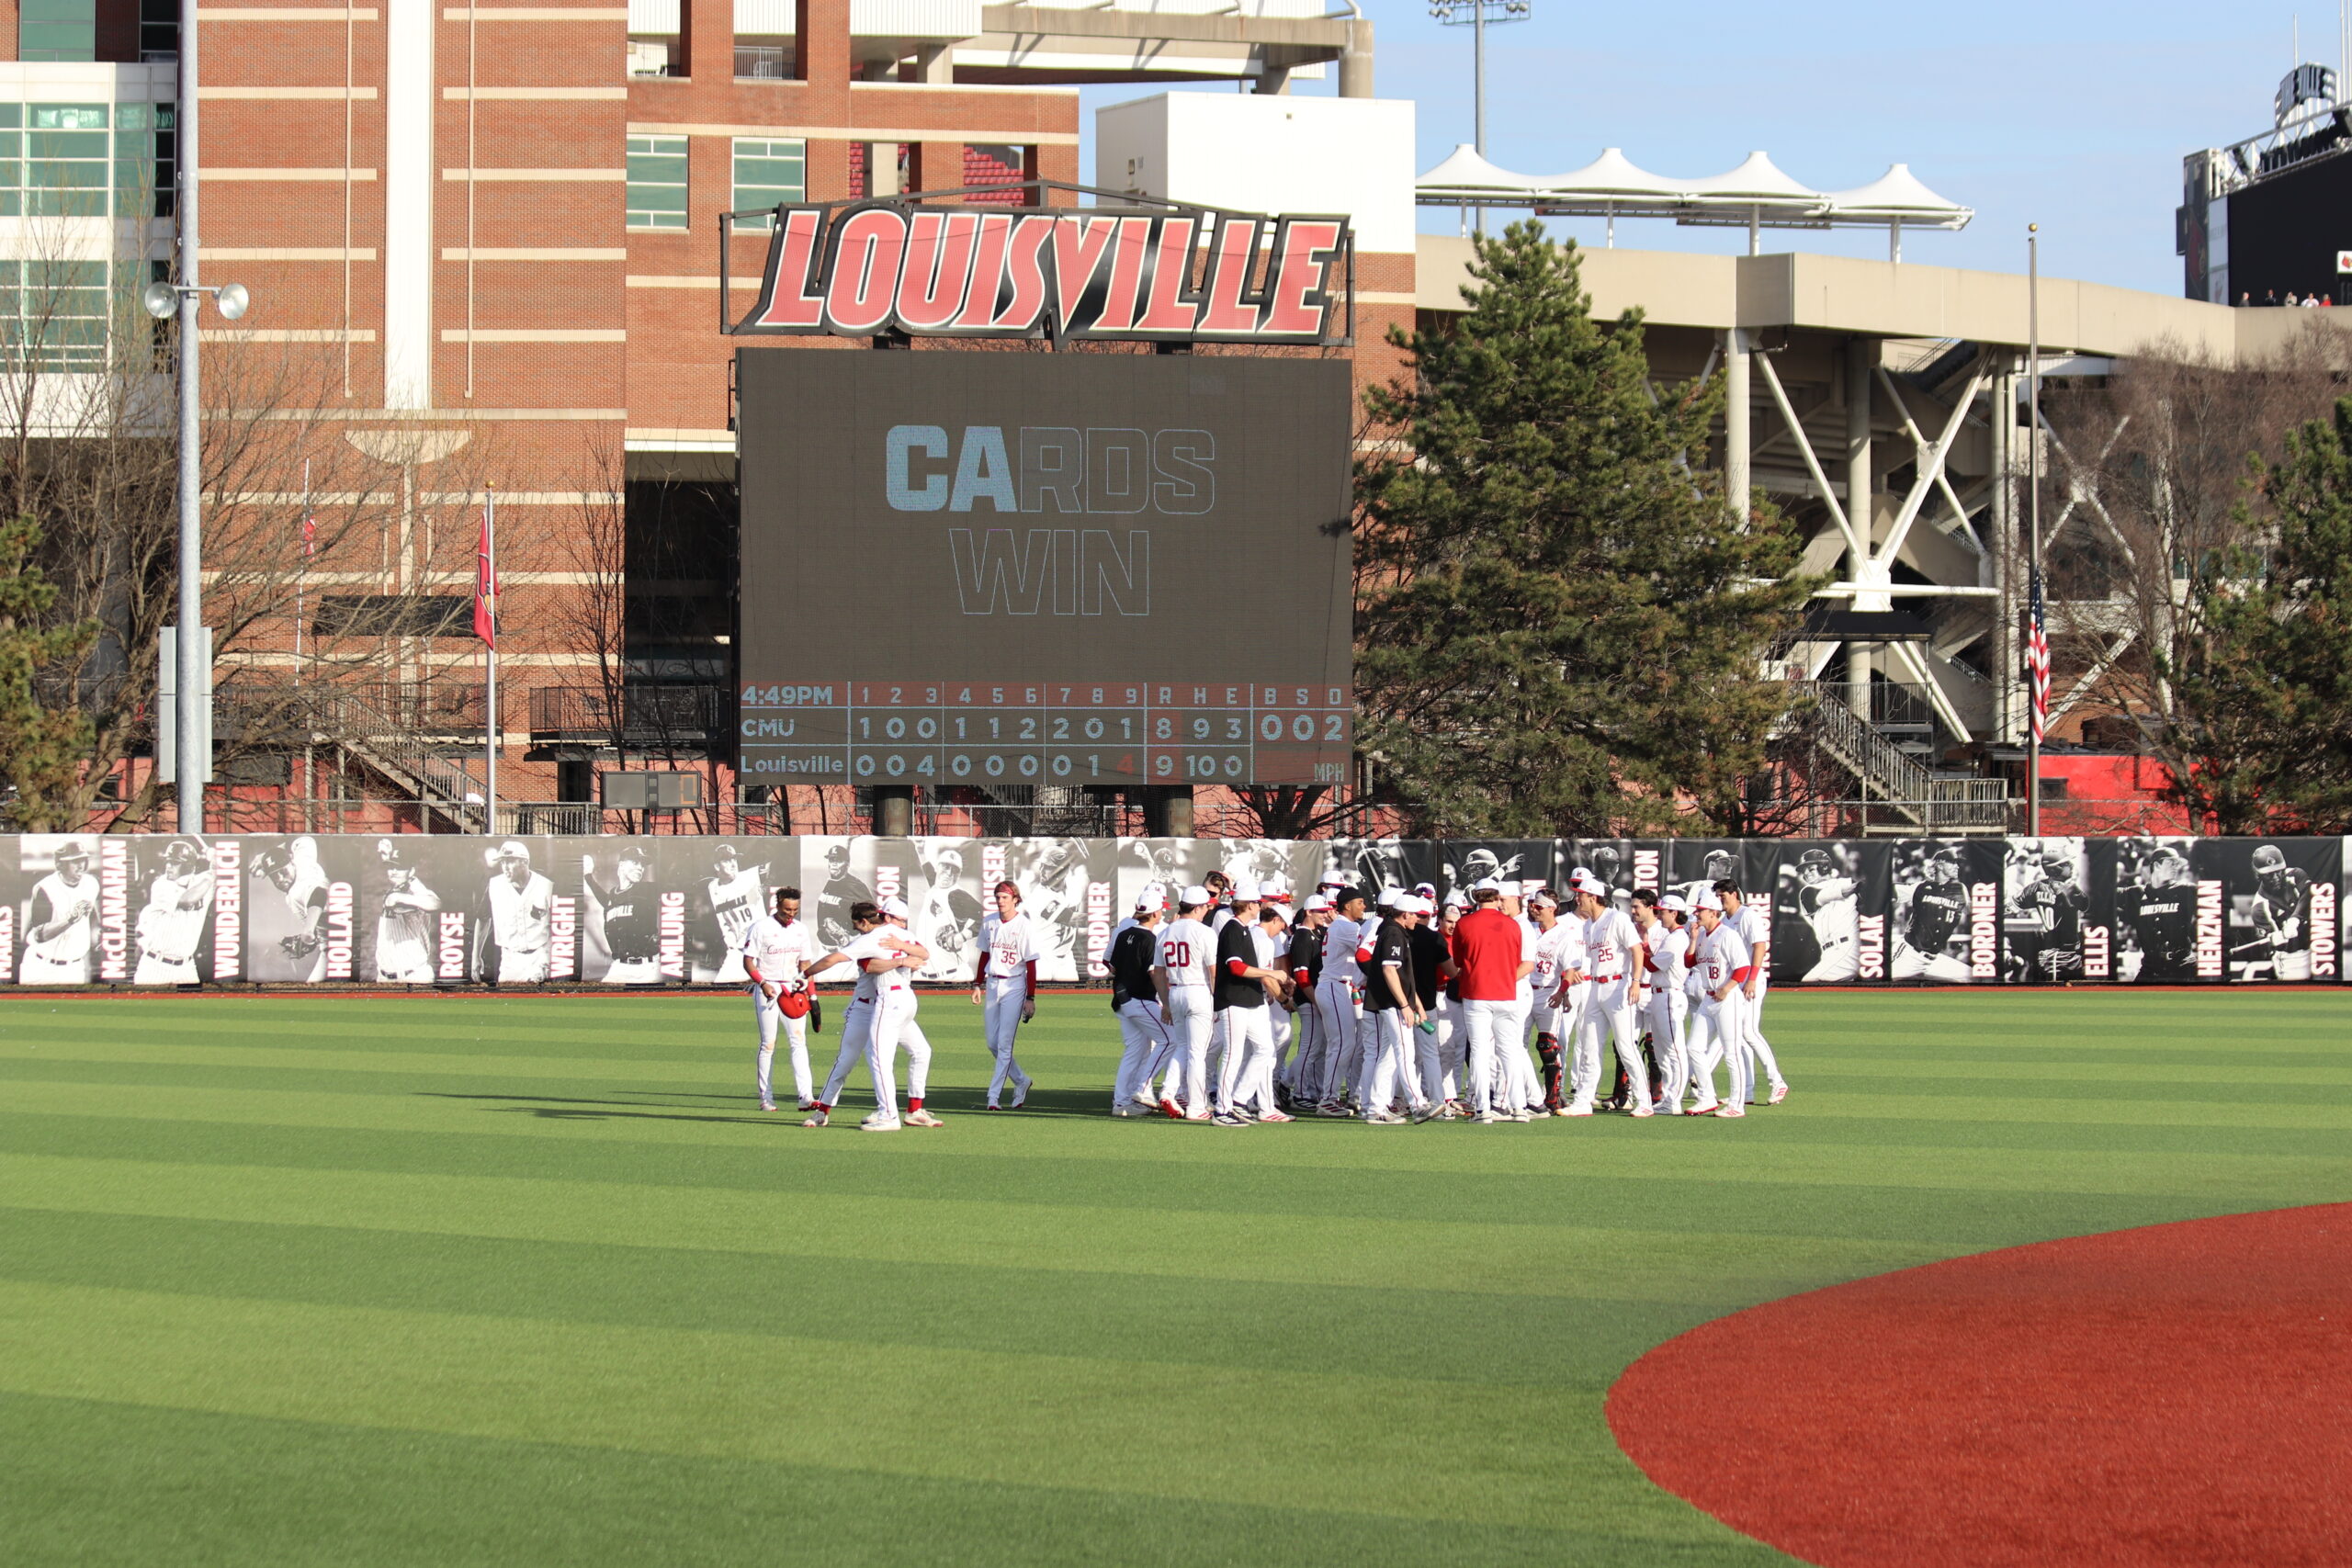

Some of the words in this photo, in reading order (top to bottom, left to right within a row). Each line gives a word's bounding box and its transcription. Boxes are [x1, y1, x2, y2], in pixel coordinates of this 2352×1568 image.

[755, 209, 1340, 336] LOUISVILLE
[886, 424, 1215, 514] CARDS
[949, 528, 1148, 615] WIN
[741, 685, 832, 705] 4:49PM
[862, 687, 868, 703] 1
[890, 687, 901, 703] 2
[926, 687, 937, 703] 3
[959, 687, 971, 703] 4
[993, 687, 1003, 703] 5
[1025, 687, 1036, 703] 6
[1060, 688, 1071, 704] 7
[1091, 688, 1102, 704] 8
[1125, 688, 1136, 704] 9
[1159, 688, 1171, 704] R
[1194, 688, 1206, 704] H
[1227, 688, 1237, 704] E
[1265, 688, 1276, 704] B
[1296, 688, 1308, 704] S
[741, 719, 795, 737] CMU
[860, 717, 870, 739] 1
[886, 717, 905, 739] 0
[917, 717, 936, 739] 0
[956, 717, 966, 739] 1
[989, 717, 999, 739] 1
[1020, 717, 1035, 739] 2
[1053, 717, 1069, 739] 2
[1084, 717, 1103, 739] 0
[1121, 717, 1131, 739] 1
[1157, 717, 1172, 739] 8
[1193, 717, 1210, 739] 9
[1227, 717, 1241, 739] 3
[1261, 715, 1283, 740] 0
[1293, 715, 1315, 740] 0
[1325, 715, 1342, 740] 2
[741, 755, 843, 773] Louisville
[856, 754, 876, 776] 0
[886, 754, 905, 776] 0
[917, 754, 934, 776] 4
[952, 754, 971, 776] 0
[986, 754, 1004, 776] 0
[1019, 754, 1038, 776] 0
[1053, 754, 1071, 776] 0
[1088, 754, 1099, 776] 1
[1117, 754, 1133, 776] 4
[1156, 754, 1173, 776] 9
[1186, 755, 1216, 776] 10
[1225, 755, 1242, 776] 0
[1314, 762, 1345, 782] MPH
[214, 840, 240, 978] WUNDERLICH
[327, 882, 353, 977] HOLLAND
[1088, 882, 1110, 977] GARDNER
[1972, 882, 1996, 977] BORDNER
[2036, 891, 2056, 905] ELLIS
[2198, 881, 2222, 976] HENZMAN
[2310, 883, 2335, 976] STOWERS
[439, 912, 465, 977] ROYSE
[550, 895, 576, 978] WRIGHT
[661, 892, 685, 977] AMLUNG
[1001, 951, 1016, 964] 35
[1163, 942, 1190, 967] 20
[1391, 946, 1401, 956] 24
[1598, 948, 1614, 963] 25
[1860, 915, 1883, 978] SOLAK
[2085, 926, 2109, 976] ELLIS
[1536, 961, 1552, 975] 43
[1709, 966, 1719, 980] 18
